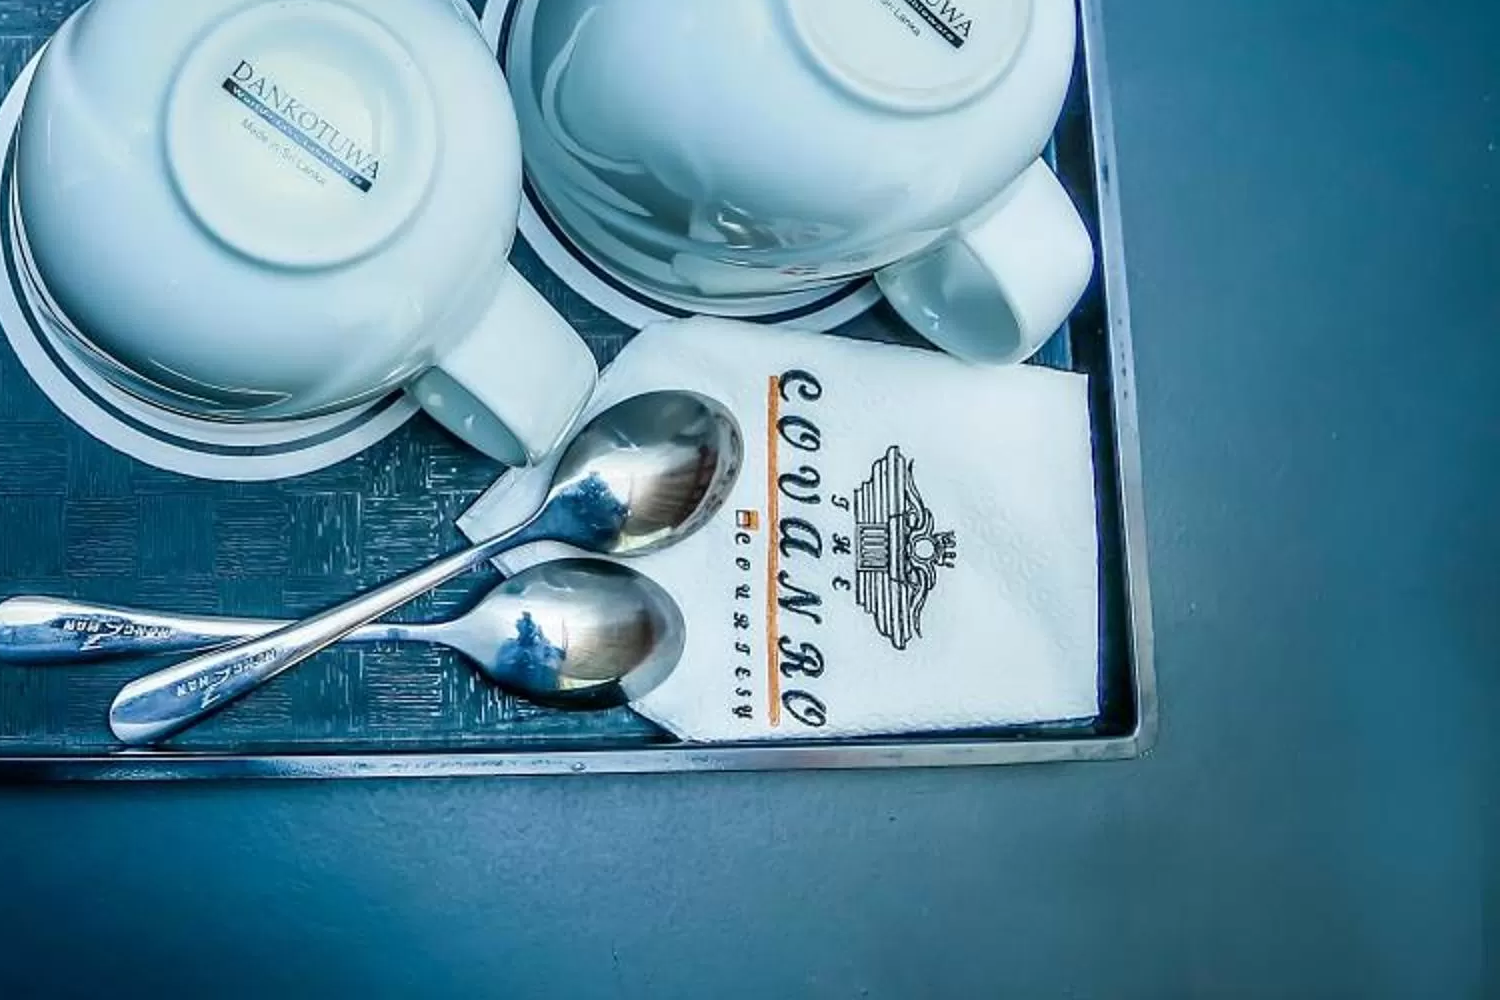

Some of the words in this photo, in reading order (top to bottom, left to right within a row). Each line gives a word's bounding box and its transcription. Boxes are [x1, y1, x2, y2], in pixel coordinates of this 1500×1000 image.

[894, 6, 921, 36] Lanka
[232, 59, 380, 180] DANKOTUWA
[831, 494, 852, 592] THE
